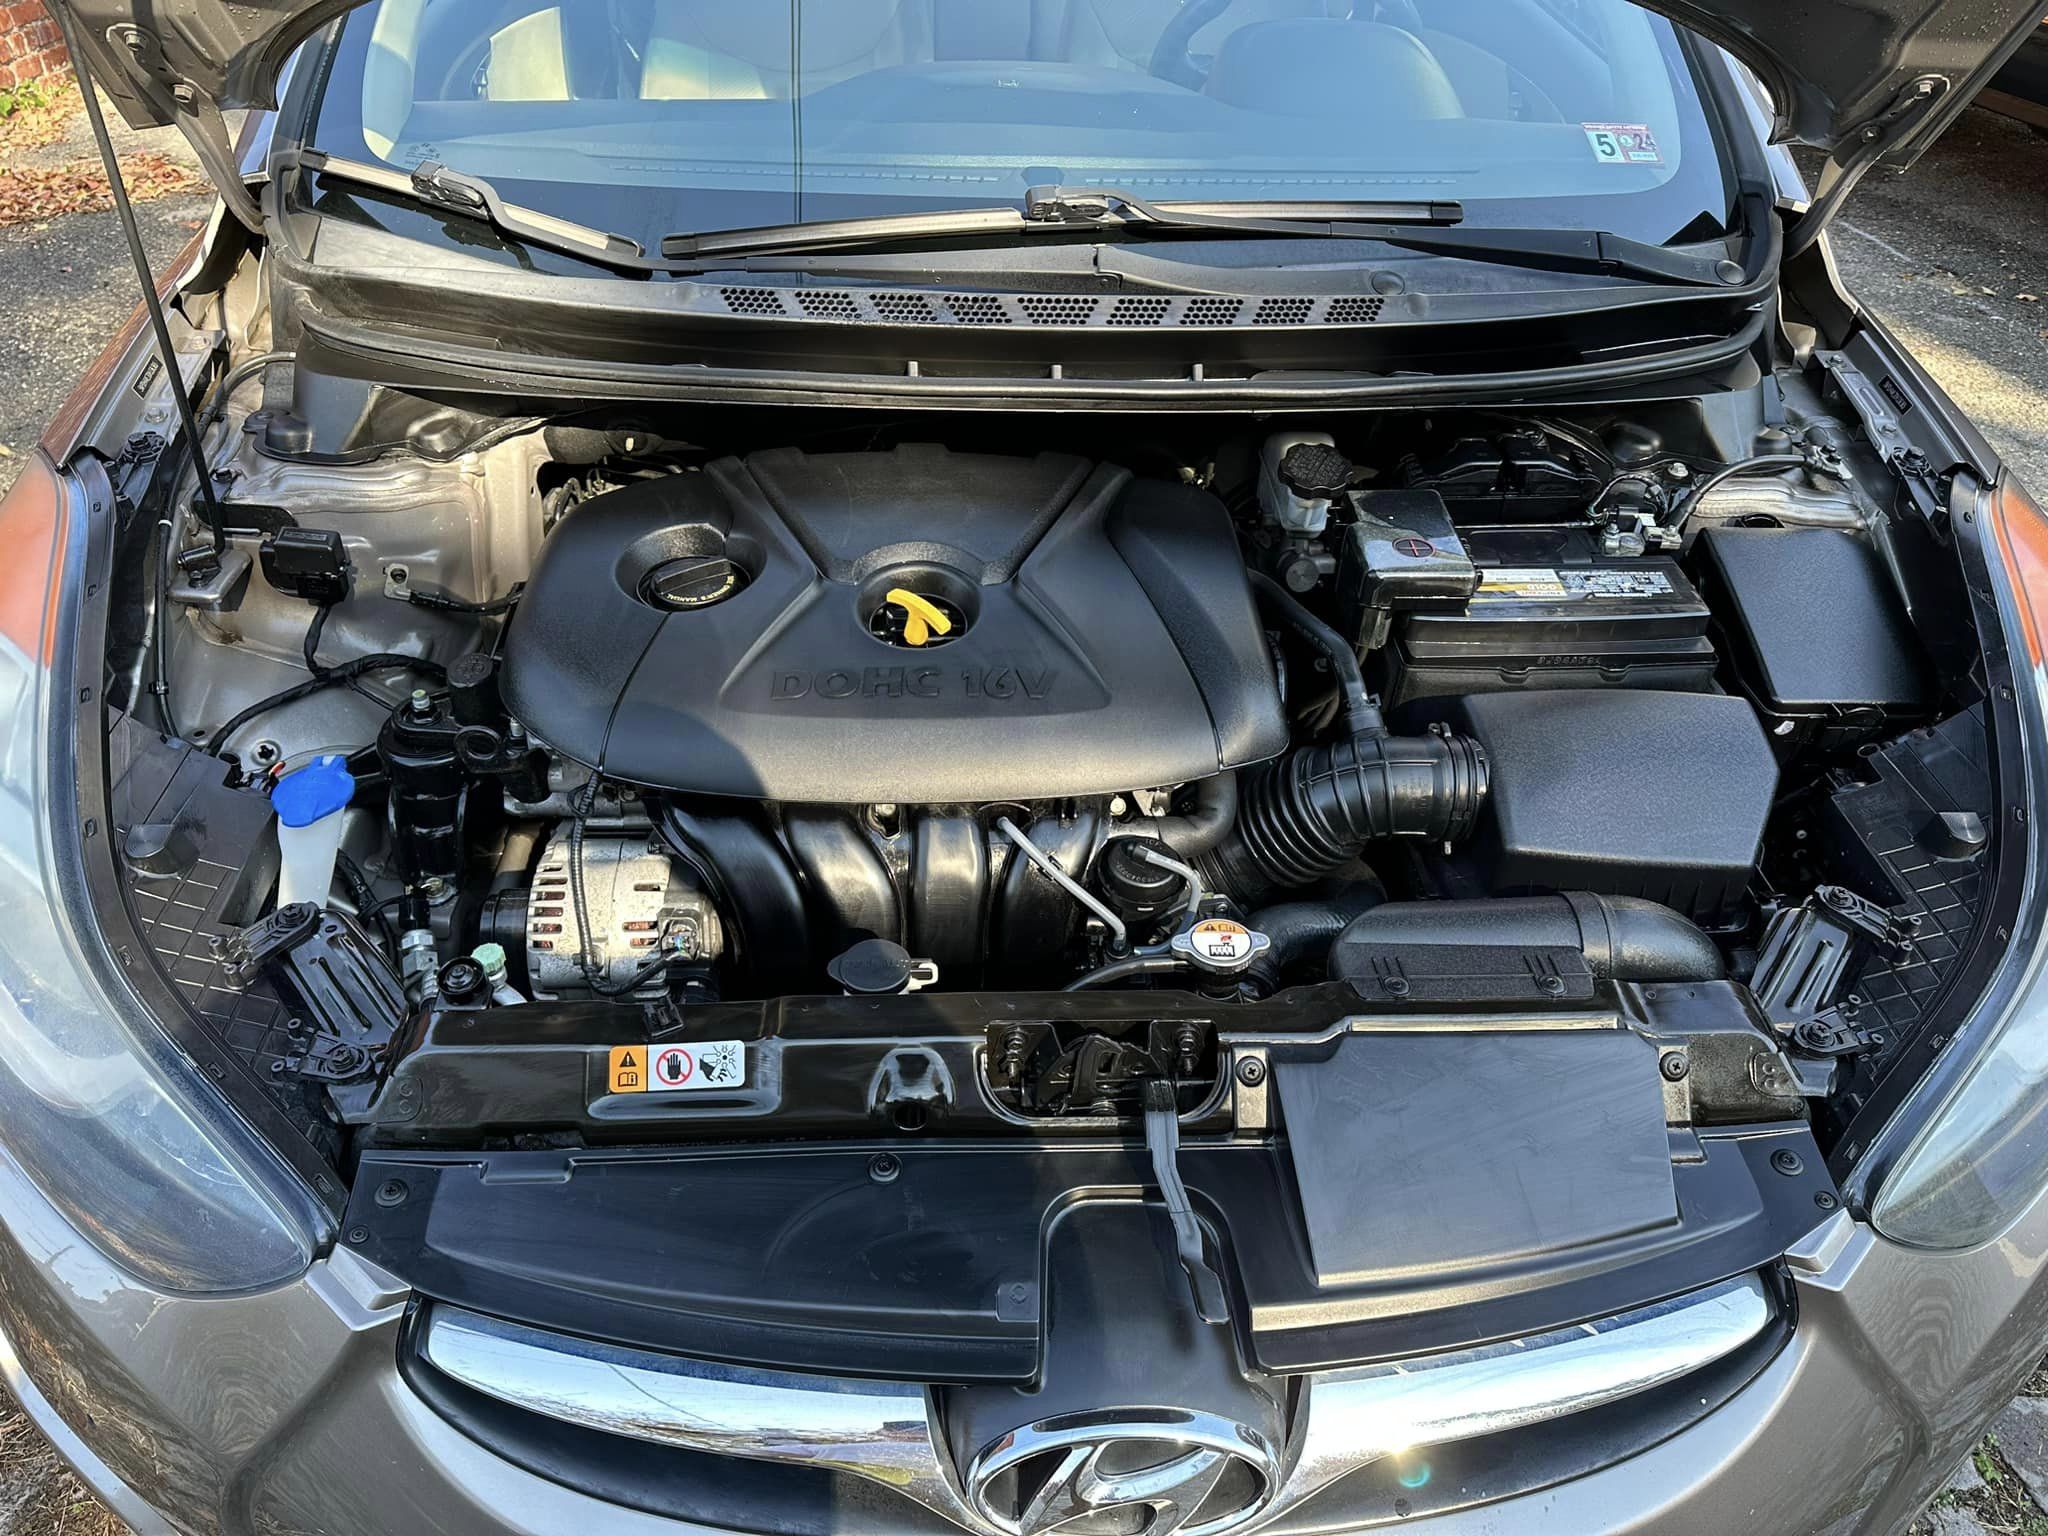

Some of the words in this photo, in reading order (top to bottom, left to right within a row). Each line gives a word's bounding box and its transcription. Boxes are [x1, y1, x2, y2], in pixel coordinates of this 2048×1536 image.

[1595, 133, 1616, 157] 5
[1633, 133, 1657, 151] 24
[666, 593, 698, 603] MANUAL
[769, 665, 943, 701] DOHC
[961, 665, 1059, 700] 16V
